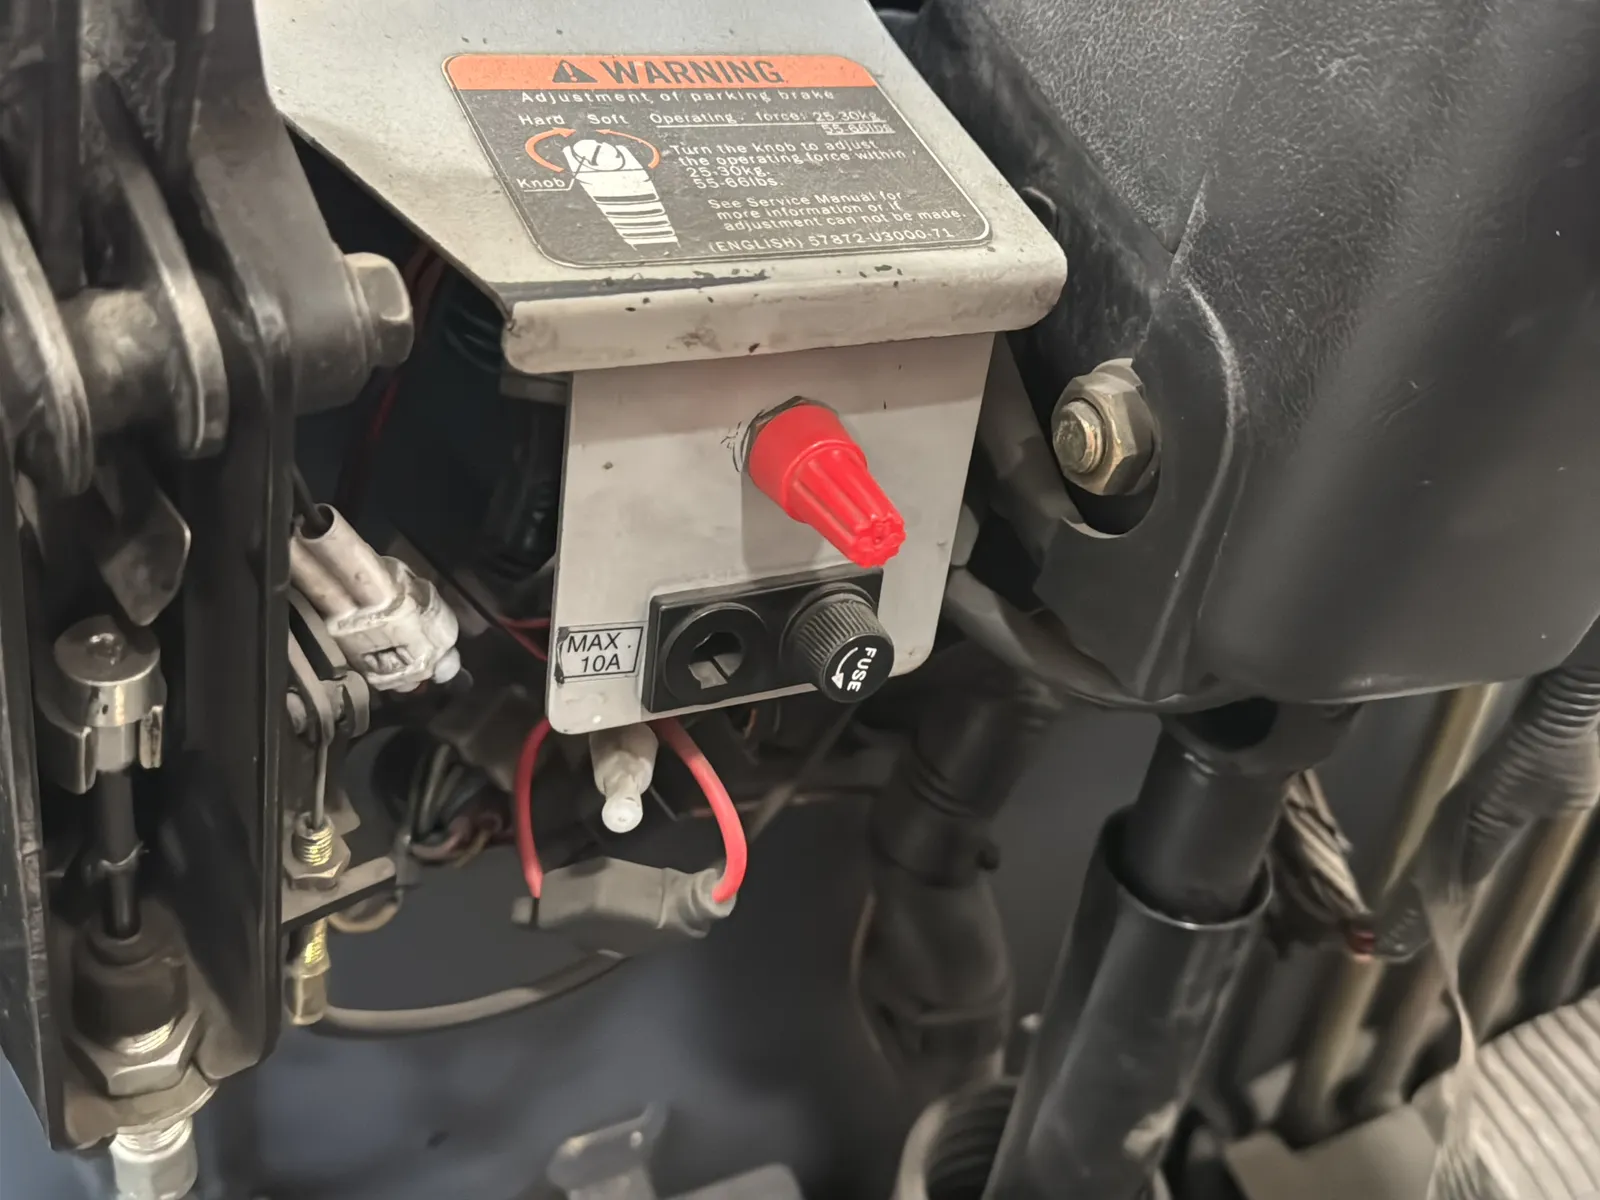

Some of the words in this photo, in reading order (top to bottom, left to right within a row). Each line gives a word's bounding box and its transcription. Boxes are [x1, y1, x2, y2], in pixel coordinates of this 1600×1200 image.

[600, 60, 784, 84] WARNING
[521, 91, 650, 104] Adjustment
[659, 92, 680, 102] of
[690, 91, 772, 103] parking
[778, 90, 835, 100] brake
[518, 114, 566, 126] Hard
[587, 113, 629, 125] Soft
[669, 143, 713, 155] Turn
[716, 143, 747, 154] the
[752, 141, 797, 153] knob
[800, 142, 819, 151] to
[824, 139, 879, 153] adjust
[679, 155, 711, 167] the
[716, 154, 805, 167] operating
[806, 151, 851, 163] force
[857, 149, 906, 161] within
[686, 165, 771, 178] 25-30kg.
[516, 177, 566, 189] Knob
[693, 176, 785, 189] 55-66lbs.
[707, 198, 742, 210] See
[749, 195, 811, 208] Service
[813, 191, 876, 205] Manual
[880, 190, 902, 201] for
[716, 209, 761, 220] more
[766, 203, 863, 218] information
[867, 203, 884, 212] or
[887, 200, 902, 211] if
[723, 217, 823, 232] adjustment
[826, 215, 857, 226] can
[860, 213, 890, 224] not
[892, 211, 913, 222] be
[917, 208, 967, 220] made.
[708, 236, 804, 252] (ENGLISH)
[808, 227, 955, 247] 57872-U3000-71
[581, 655, 622, 673] 10A
[847, 647, 877, 692] FUSE
